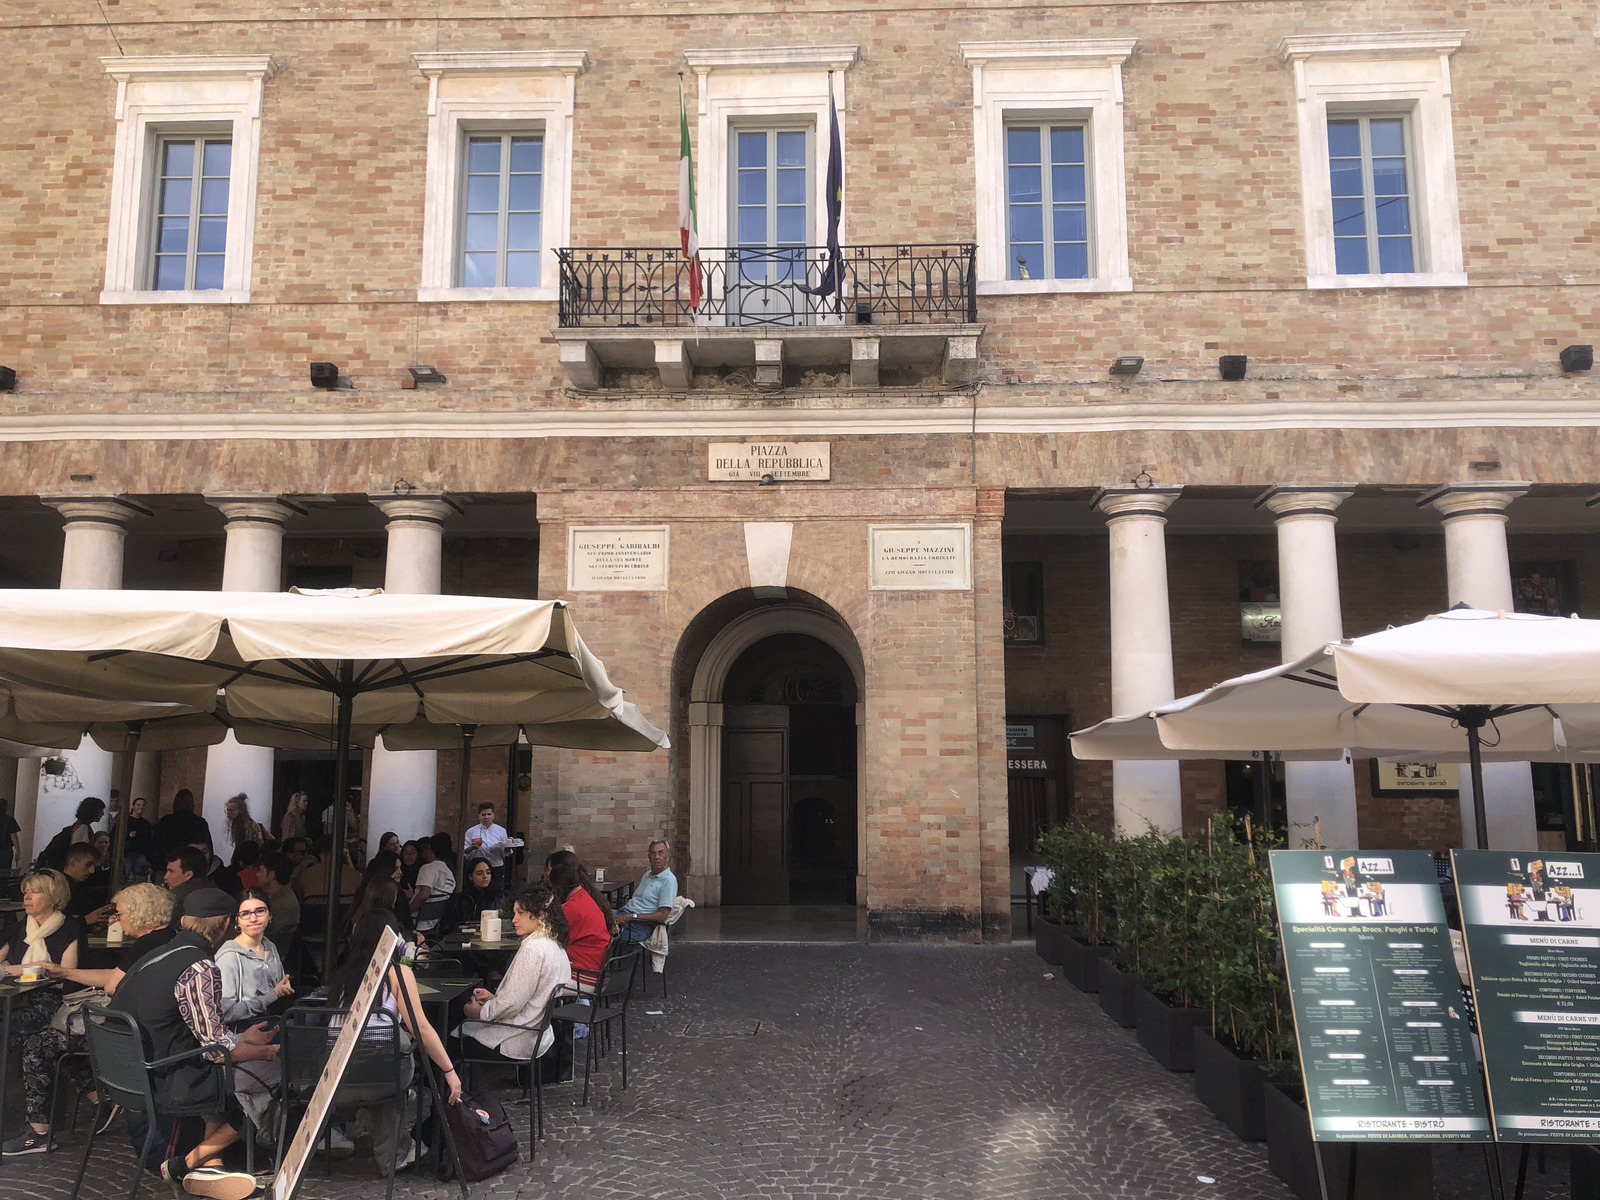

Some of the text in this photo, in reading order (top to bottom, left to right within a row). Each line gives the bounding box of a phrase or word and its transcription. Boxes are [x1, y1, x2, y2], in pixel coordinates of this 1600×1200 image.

[751, 445, 788, 456] PIAZZA
[716, 458, 823, 469] DELLA REPUBBLICA
[1008, 760, 1047, 769] ESSERA
[1292, 925, 1326, 934] Specialità
[1385, 926, 1408, 935] Funghi
[1414, 926, 1439, 935] Tartufi
[1529, 936, 1549, 944] MENÙ
[1557, 937, 1579, 945] CARNE
[1358, 1120, 1407, 1128] RISTORANTE
[1414, 1118, 1445, 1128] BISTRÒ
[1540, 1119, 1590, 1128] RISTORANTE
